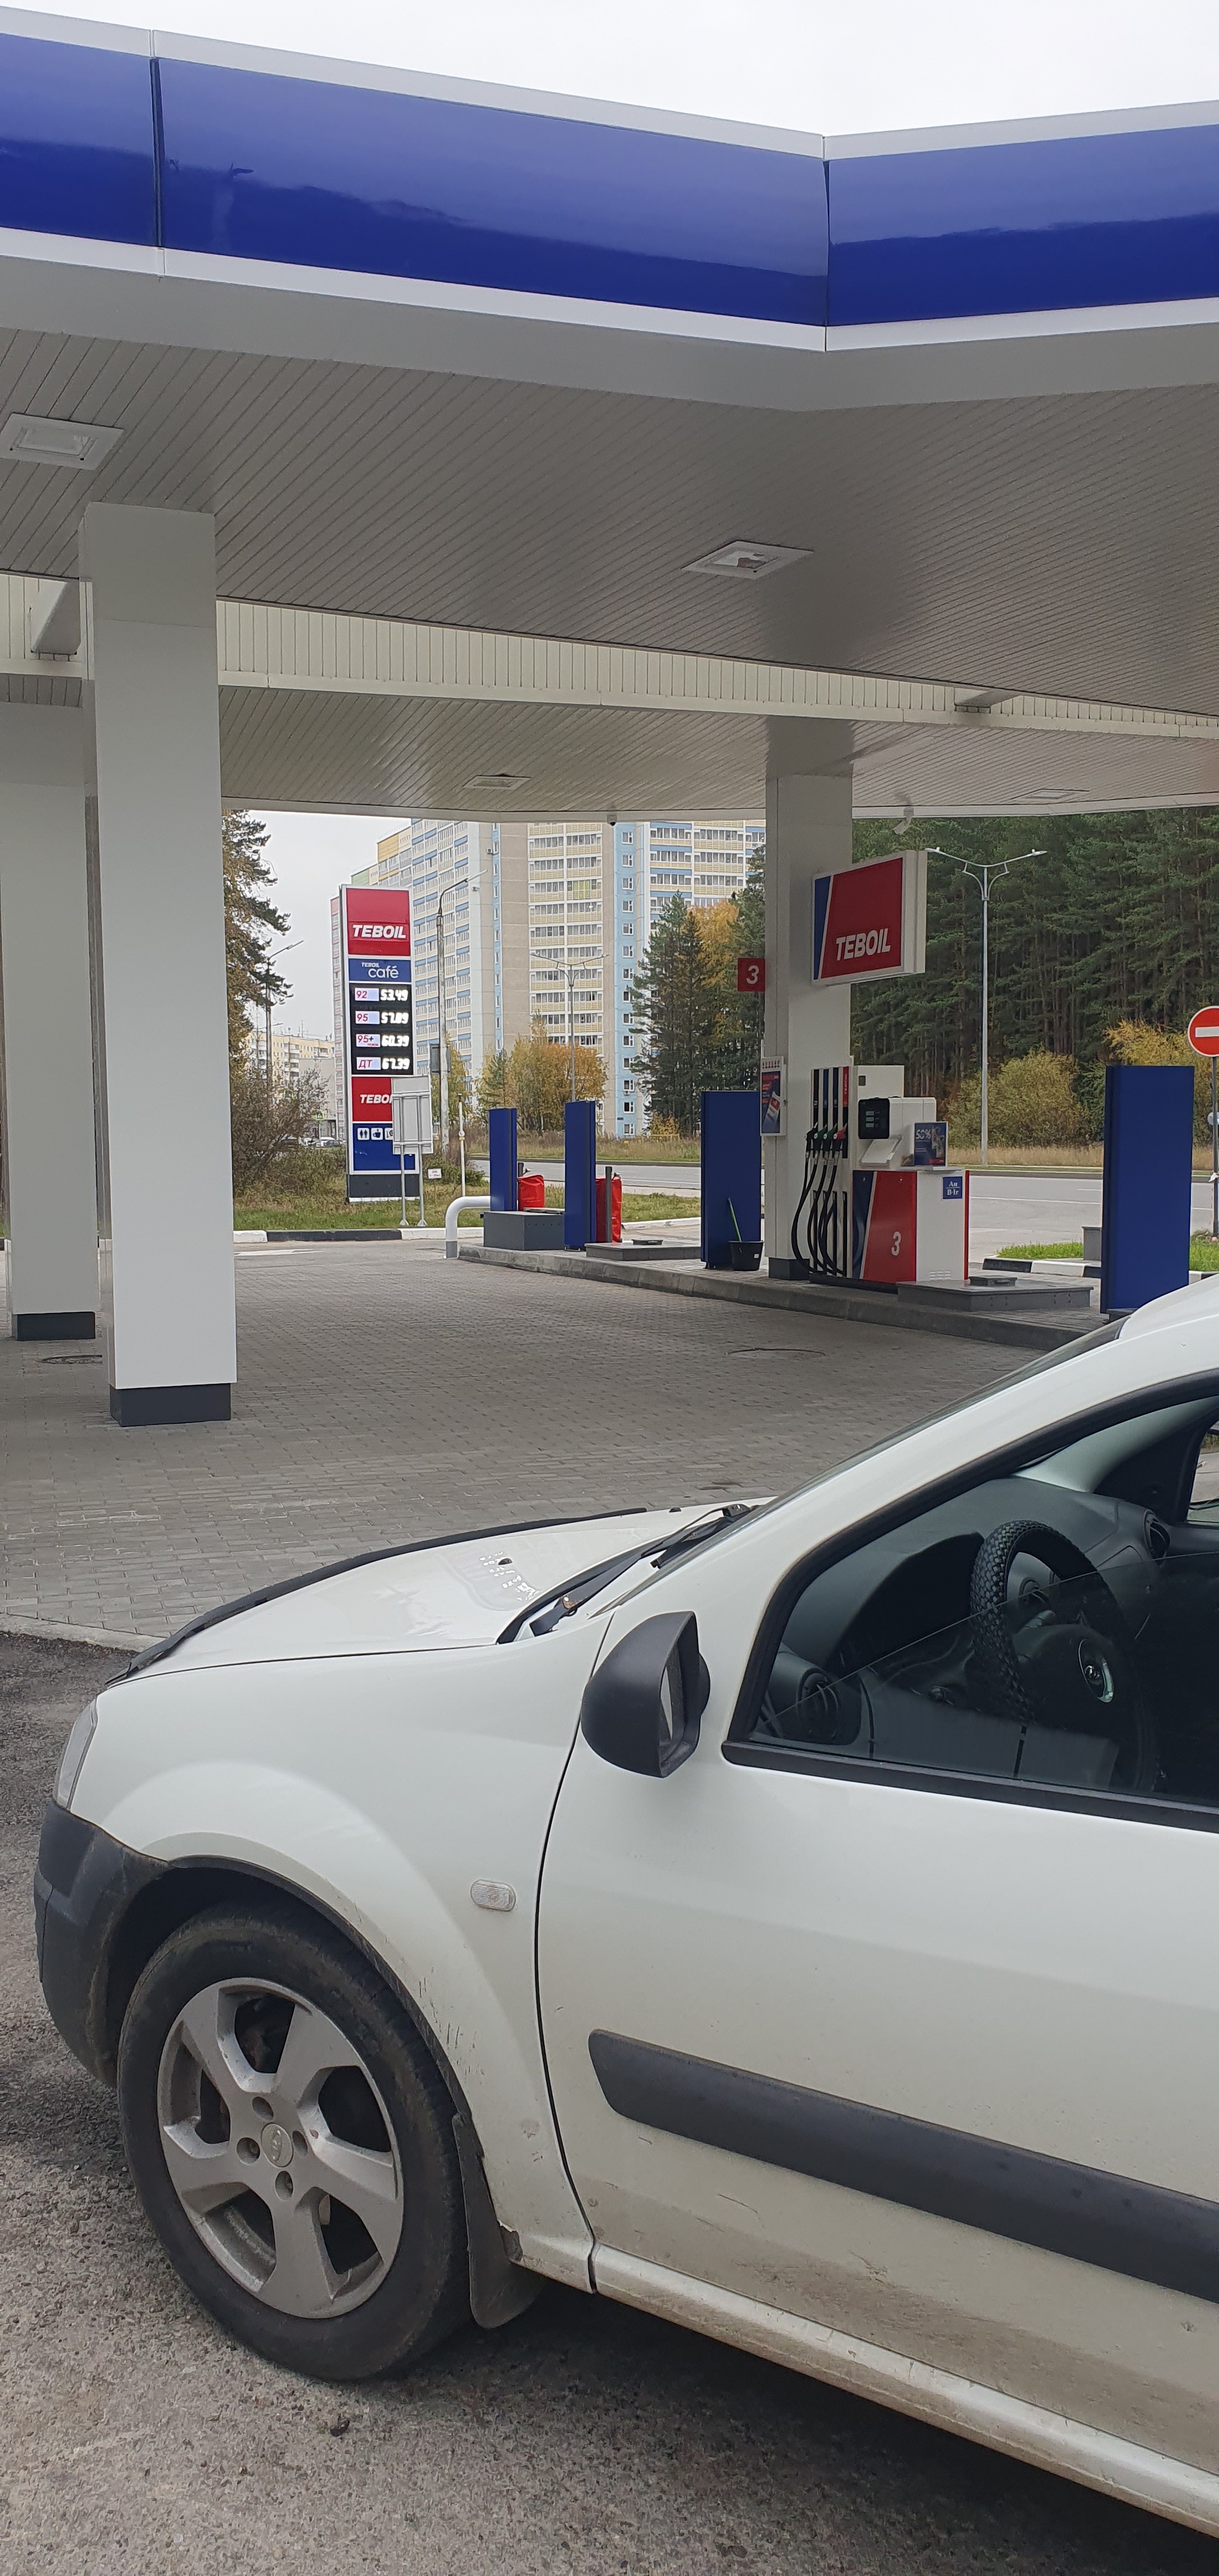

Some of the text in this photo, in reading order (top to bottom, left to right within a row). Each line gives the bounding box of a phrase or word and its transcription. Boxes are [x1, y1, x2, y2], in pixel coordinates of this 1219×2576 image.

[353, 924, 406, 939] TEBOIL
[836, 928, 891, 961] TEBOIL
[368, 965, 399, 979] café
[746, 965, 759, 984] 3
[356, 989, 408, 1001] 92 53.49
[356, 1013, 368, 1022] 95
[357, 1034, 410, 1046] 95+ 60.39
[358, 1058, 410, 1070] ДТ 67.39
[891, 1231, 901, 1256] 3
